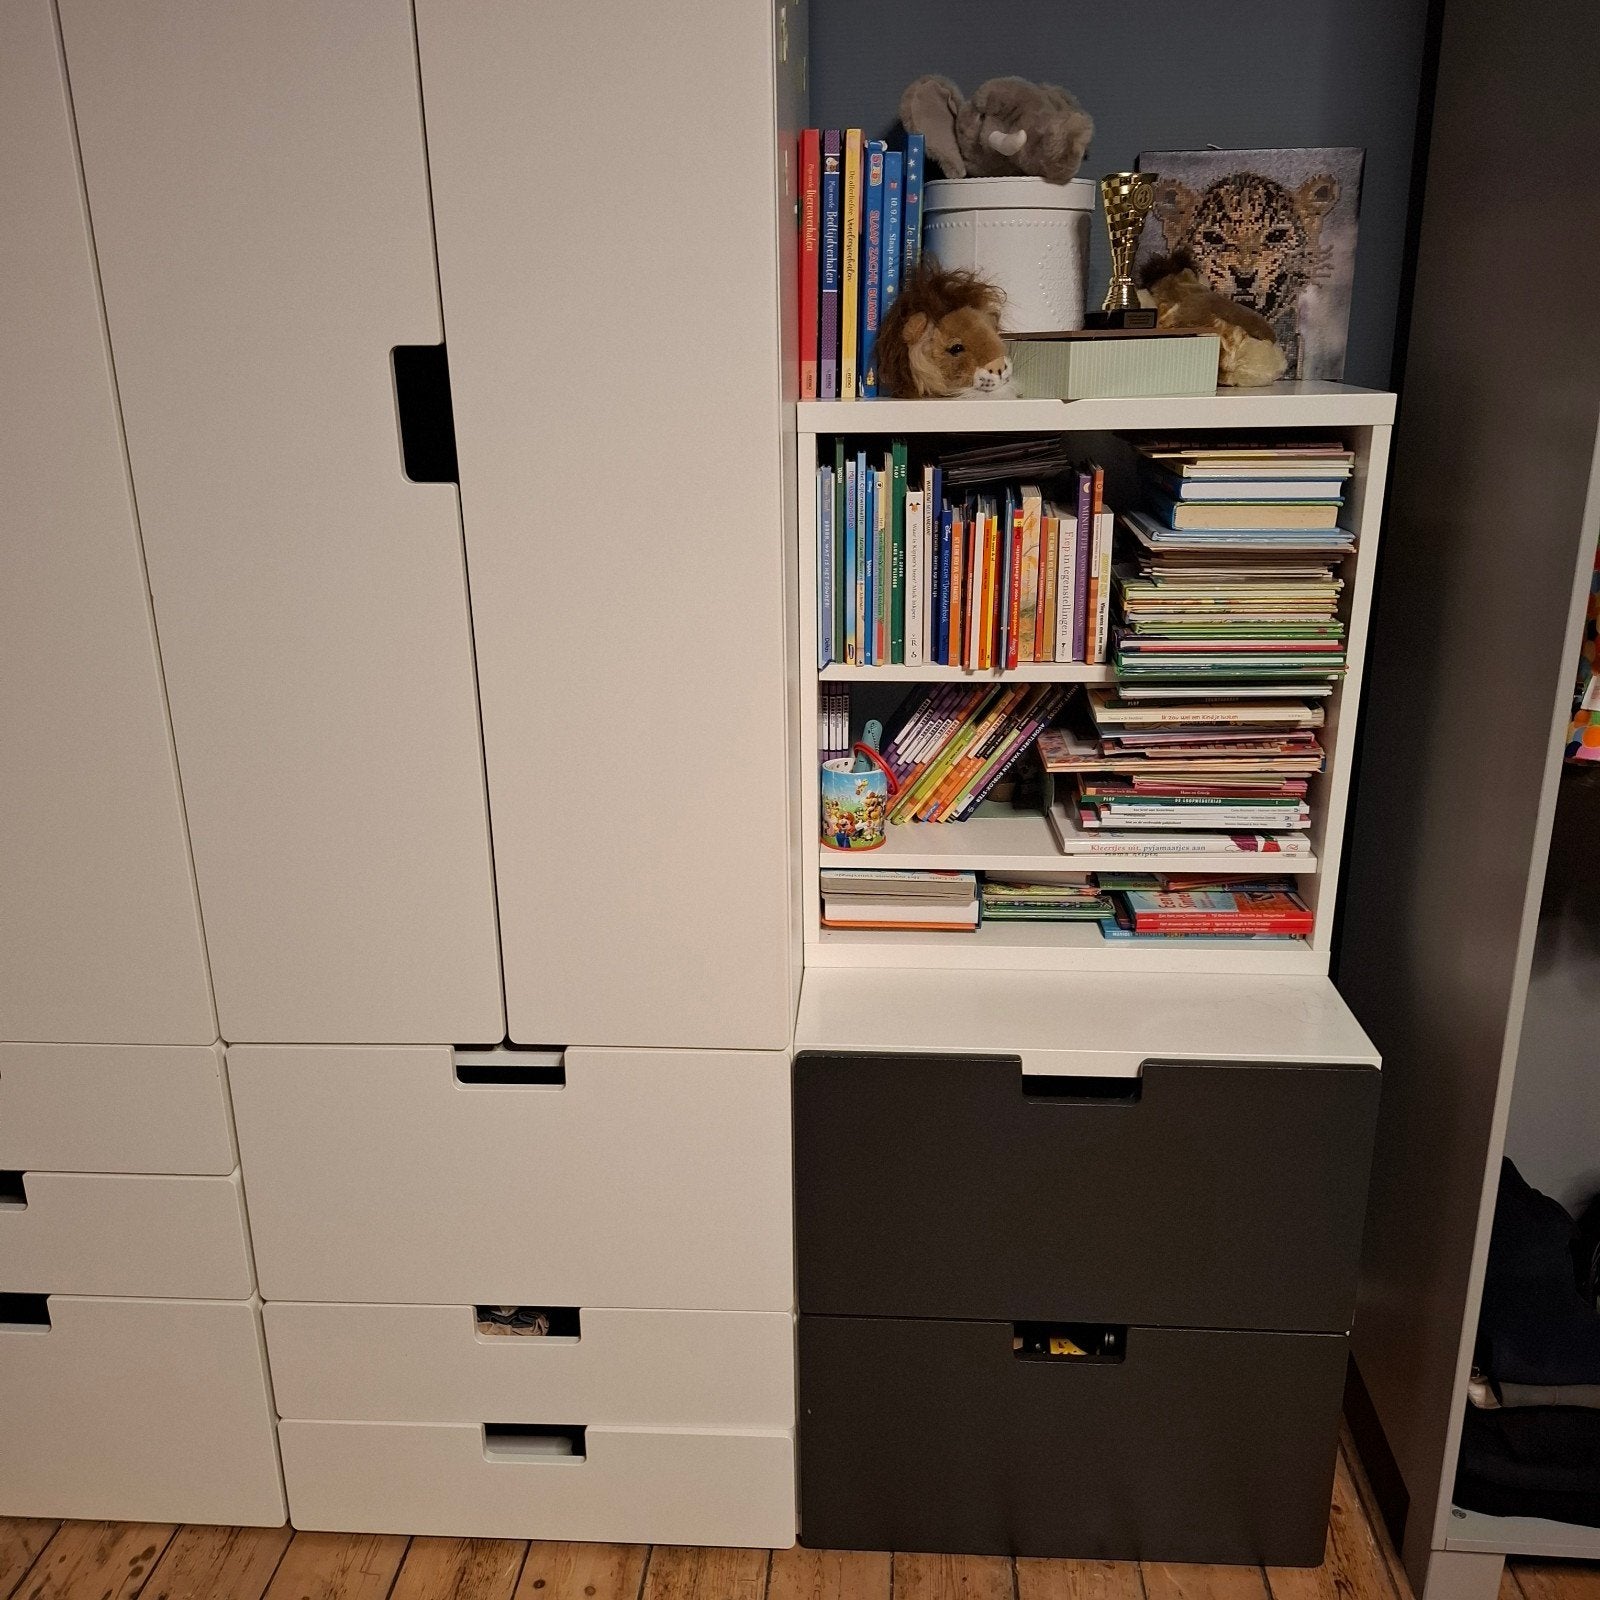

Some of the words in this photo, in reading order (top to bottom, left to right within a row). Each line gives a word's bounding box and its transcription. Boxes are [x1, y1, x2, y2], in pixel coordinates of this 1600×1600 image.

[849, 170, 856, 179] De
[805, 190, 816, 251] Dierenverhalen
[870, 210, 880, 245] SLAAP
[907, 225, 916, 235] Je
[825, 211, 838, 283] Bedtijdverhalen
[888, 233, 896, 254] Slaap
[1081, 506, 1090, 551] MINUUTJE
[1062, 532, 1073, 552] Fiep
[1064, 554, 1072, 564] in
[1060, 566, 1071, 636] tegenstellingen
[1019, 723, 1045, 752] AVONTUREN
[1002, 762, 1012, 772] EEN
[1010, 752, 1021, 762] VAN
